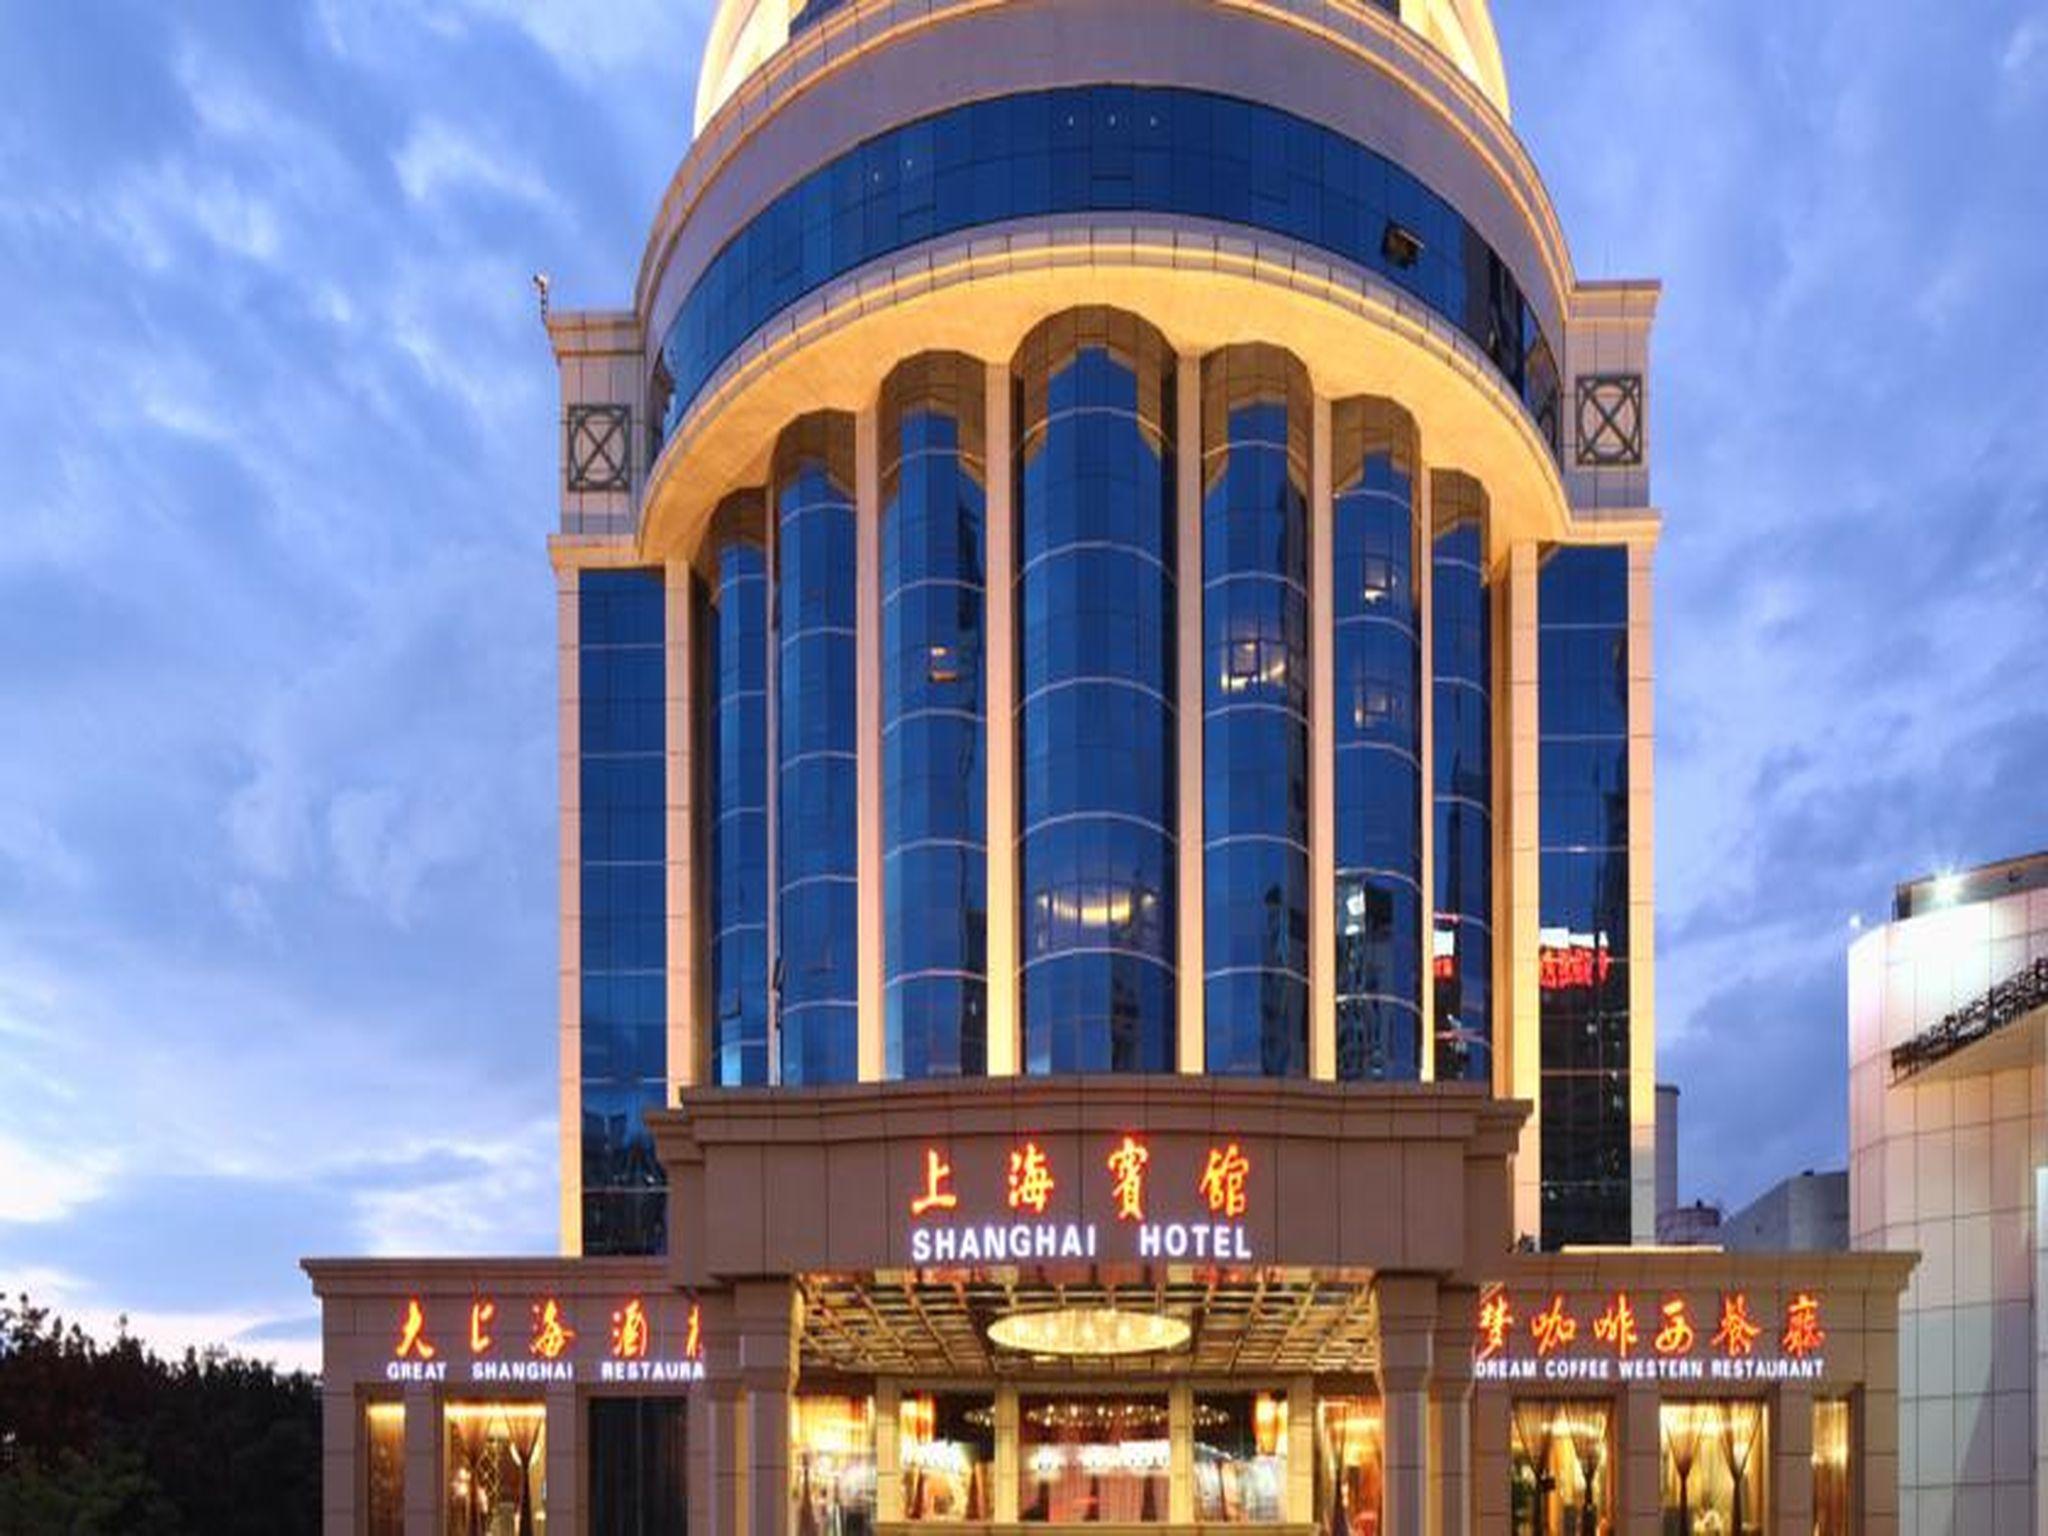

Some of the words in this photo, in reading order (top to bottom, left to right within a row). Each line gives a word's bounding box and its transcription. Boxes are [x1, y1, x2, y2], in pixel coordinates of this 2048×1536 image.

[911, 1223, 1097, 1260] SHANGHAI
[1139, 1222, 1253, 1259] HOTEL
[386, 1361, 447, 1380] GREAT
[472, 1361, 574, 1380] SHANGHAI
[1475, 1359, 1537, 1378] DREAM
[1545, 1359, 1609, 1378] COFFEE
[1618, 1359, 1703, 1378] WESTERN
[1711, 1359, 1825, 1378] RESTAURANT
